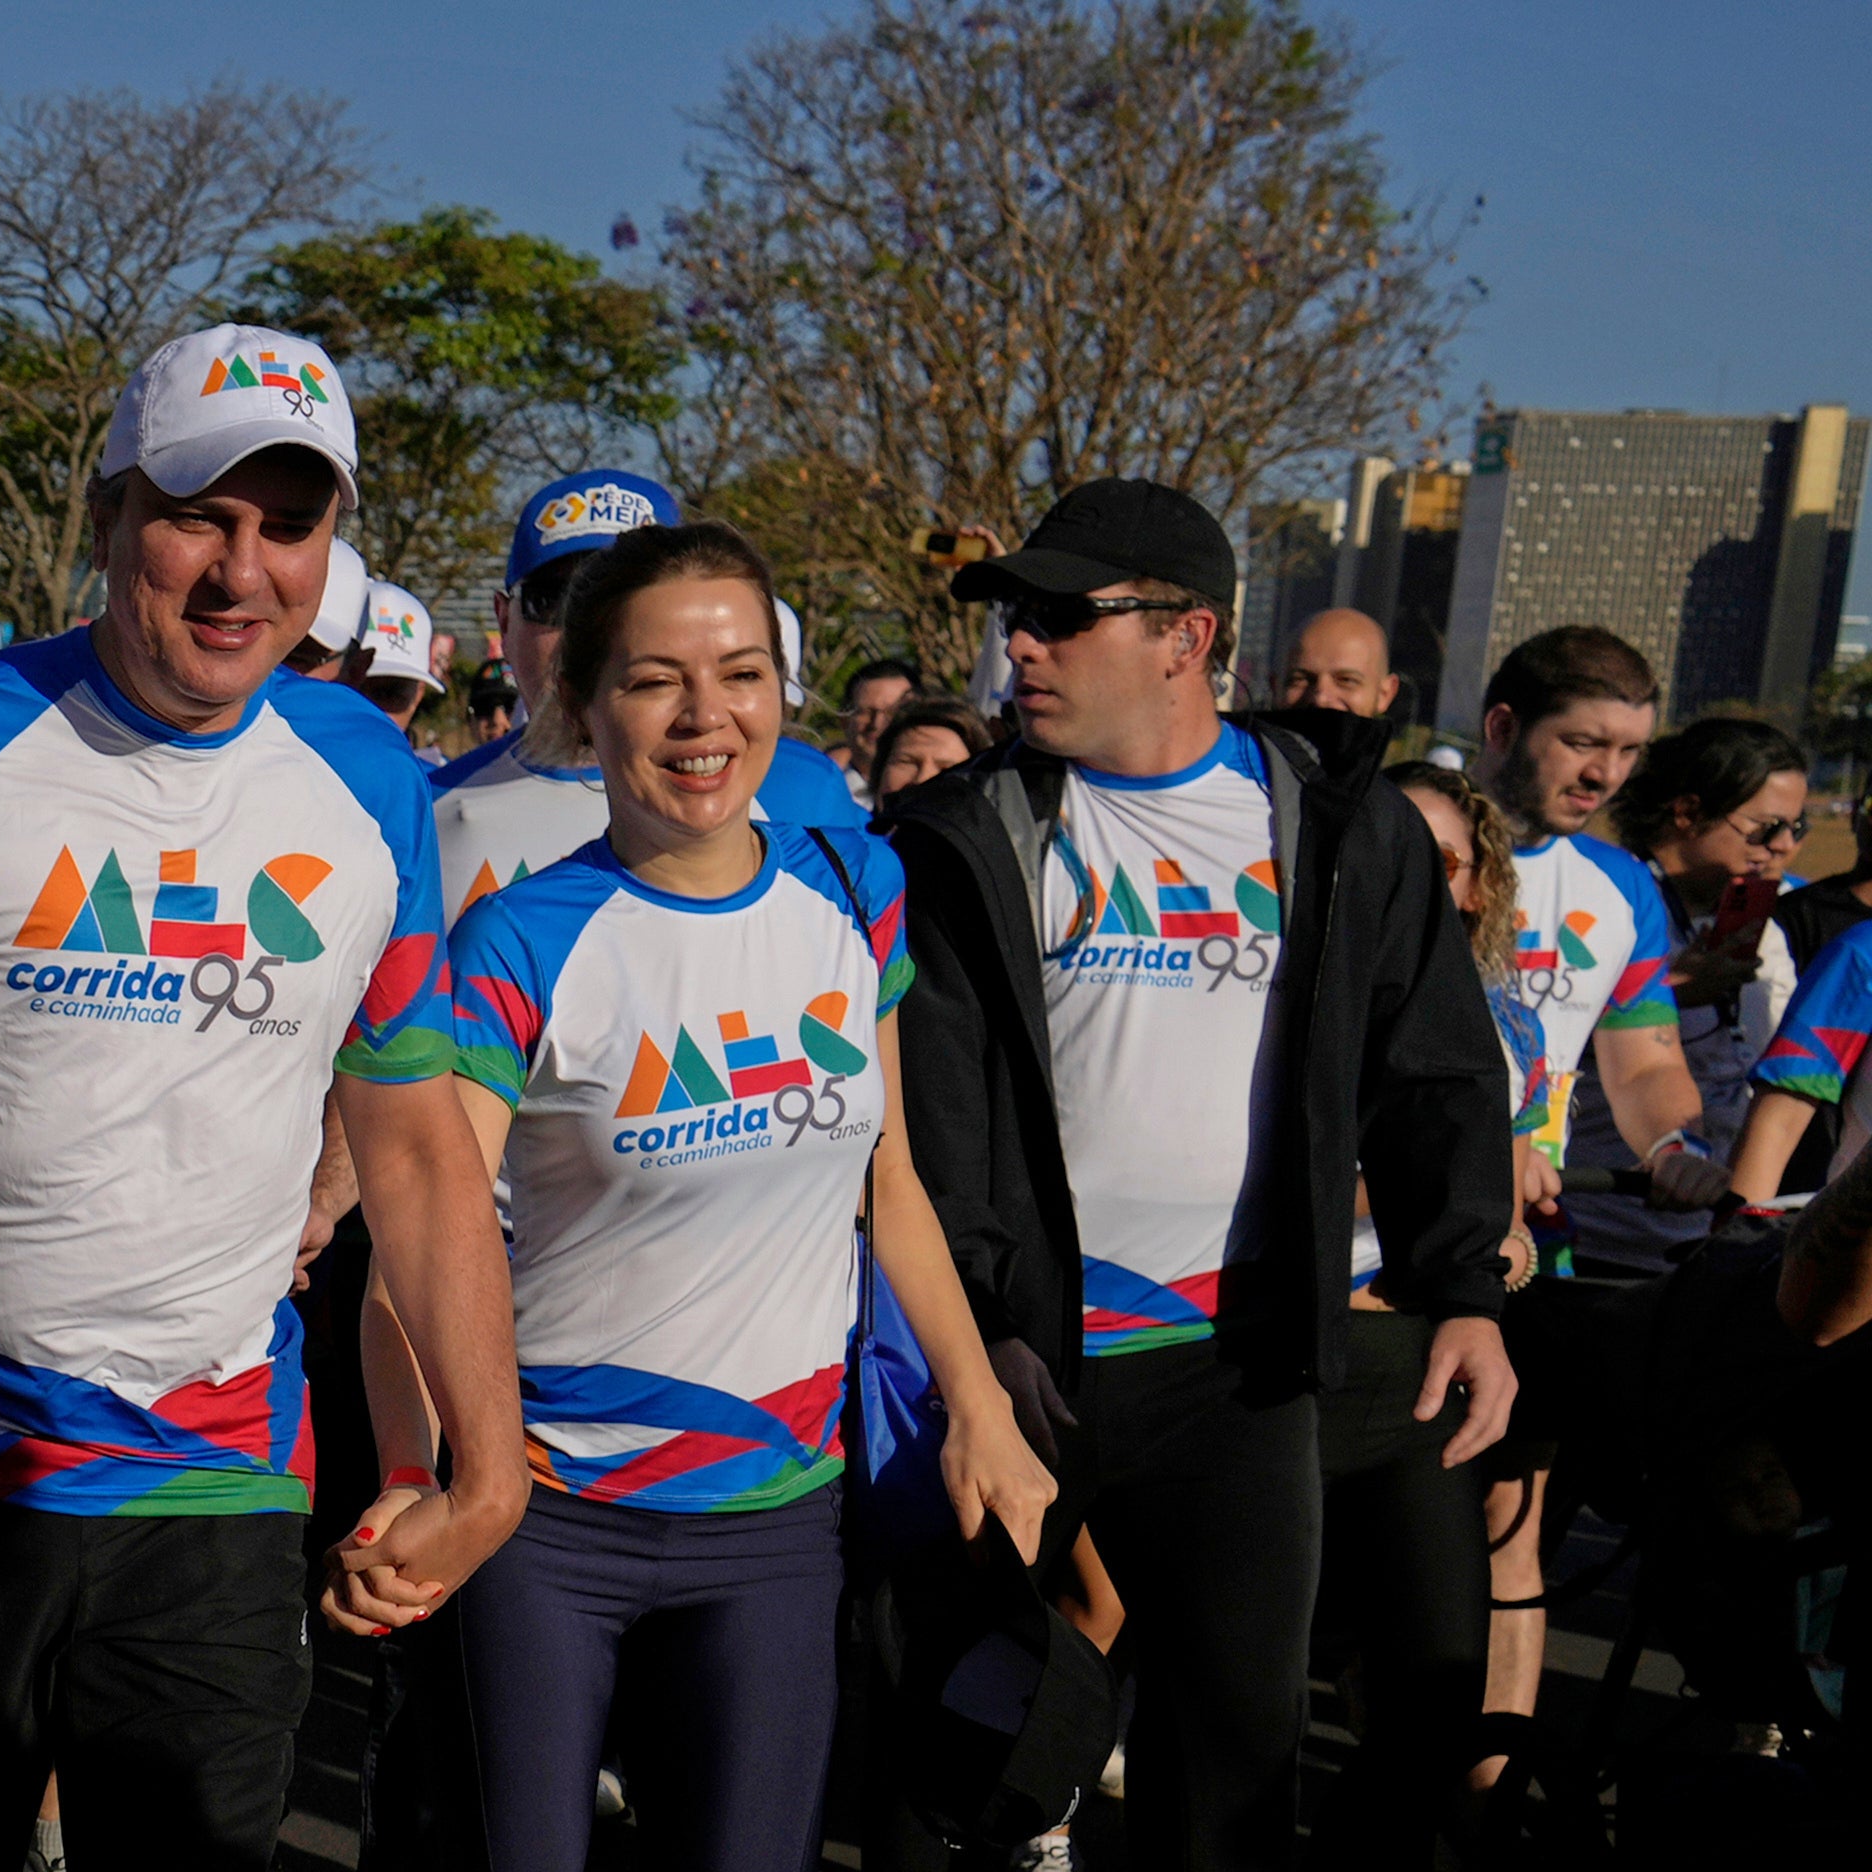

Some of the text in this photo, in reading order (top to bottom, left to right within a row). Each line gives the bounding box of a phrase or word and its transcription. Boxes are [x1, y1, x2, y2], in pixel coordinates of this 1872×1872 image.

[199, 351, 330, 404] MEC
[283, 388, 316, 418] 95
[589, 505, 653, 527] MEIA
[12, 844, 334, 962] MEC
[1089, 969, 1195, 989] caminhada
[1196, 932, 1275, 992] 95
[6, 954, 288, 1033] corrida 95
[1527, 967, 1579, 1011] 95
[29, 997, 302, 1037] e caminhada anos
[614, 990, 869, 1119] MEC
[612, 1073, 847, 1157] corrida 95
[638, 1116, 873, 1170] e caminhada anos
